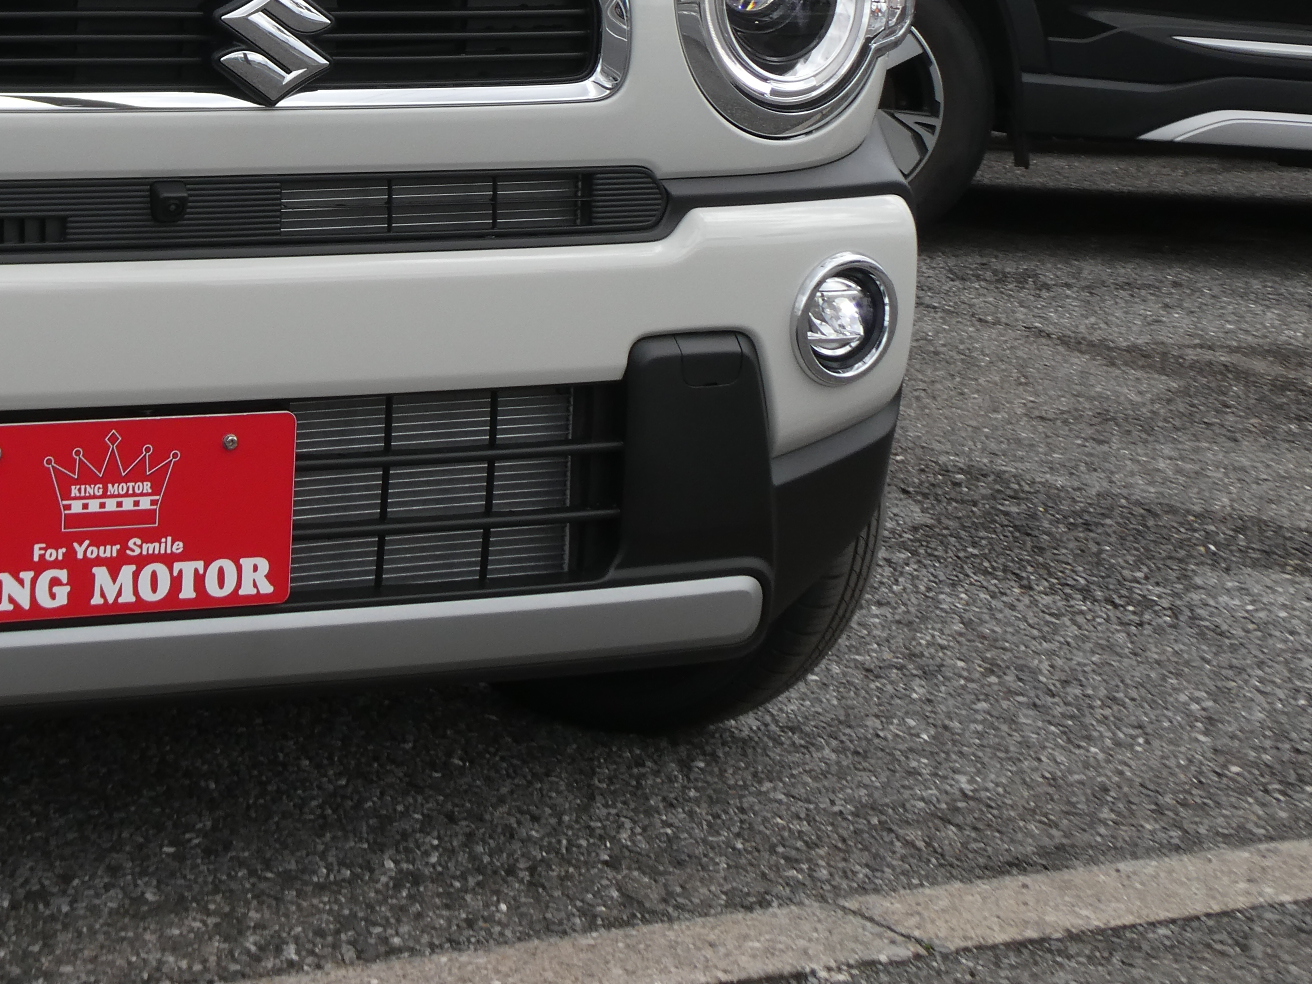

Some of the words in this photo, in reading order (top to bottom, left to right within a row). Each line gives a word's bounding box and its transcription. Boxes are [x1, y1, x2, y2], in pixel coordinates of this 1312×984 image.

[70, 483, 104, 497] KING
[107, 481, 152, 495] MOTOR
[33, 543, 67, 562] For
[73, 539, 121, 559] Your
[126, 536, 184, 557] Smile
[90, 557, 275, 606] MOTOR
